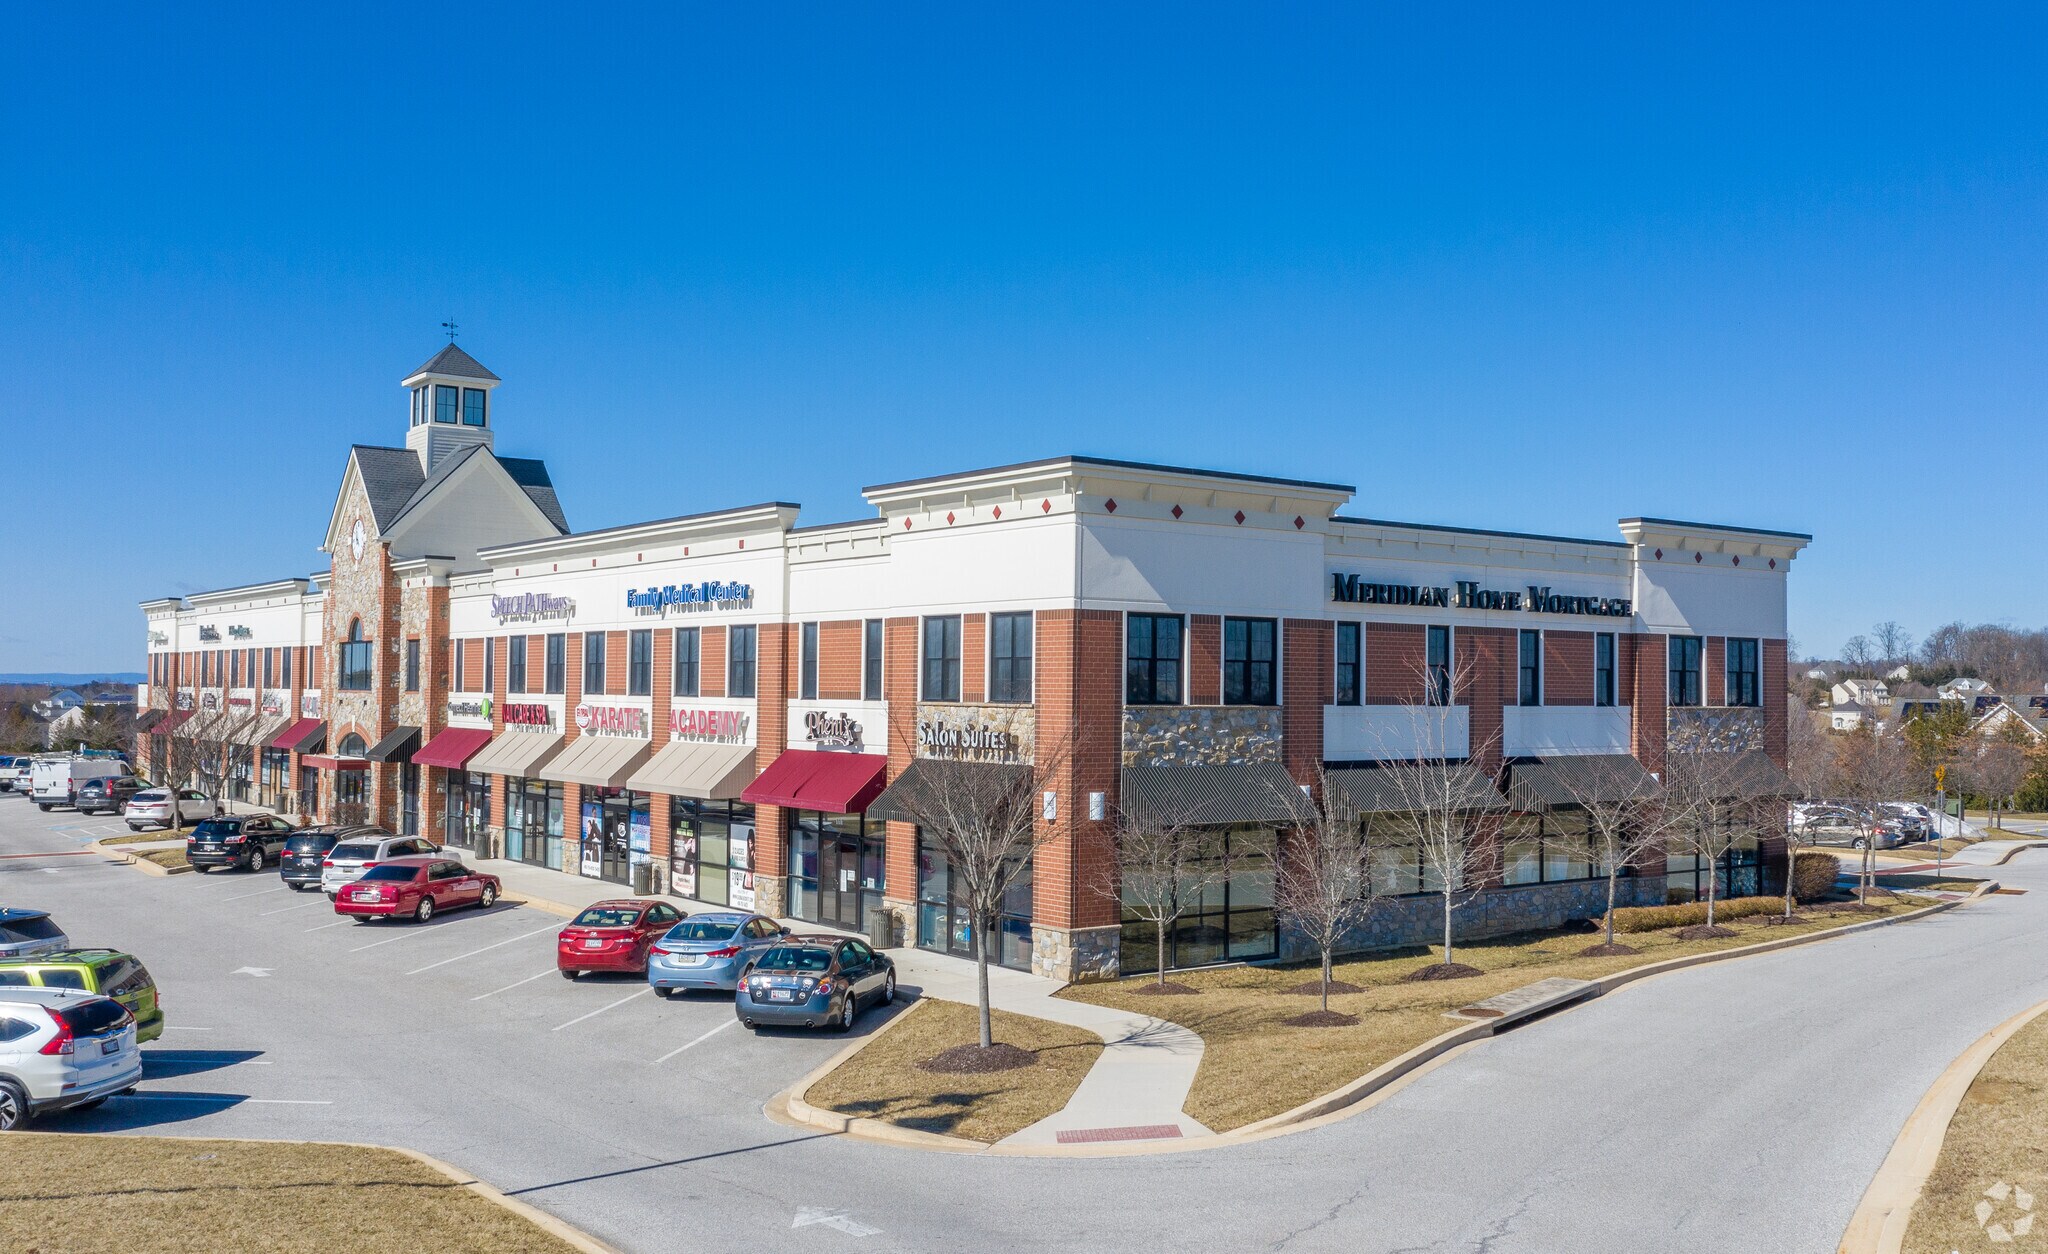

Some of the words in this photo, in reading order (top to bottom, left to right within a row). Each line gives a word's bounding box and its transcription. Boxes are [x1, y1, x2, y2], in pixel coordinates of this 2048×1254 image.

[491, 593, 524, 618] SPEECH
[627, 588, 662, 612] Family
[663, 584, 708, 606] Medical
[708, 581, 748, 602] Center
[1331, 572, 1450, 608] MERIDIAN
[1455, 580, 1522, 611] HOME
[1527, 585, 1633, 617] MORTGAGE
[514, 703, 530, 724] CARE
[536, 704, 548, 725] SPA
[591, 706, 641, 731] KARATE
[669, 709, 741, 736] ACADEMY
[962, 724, 1008, 749] SUITES
